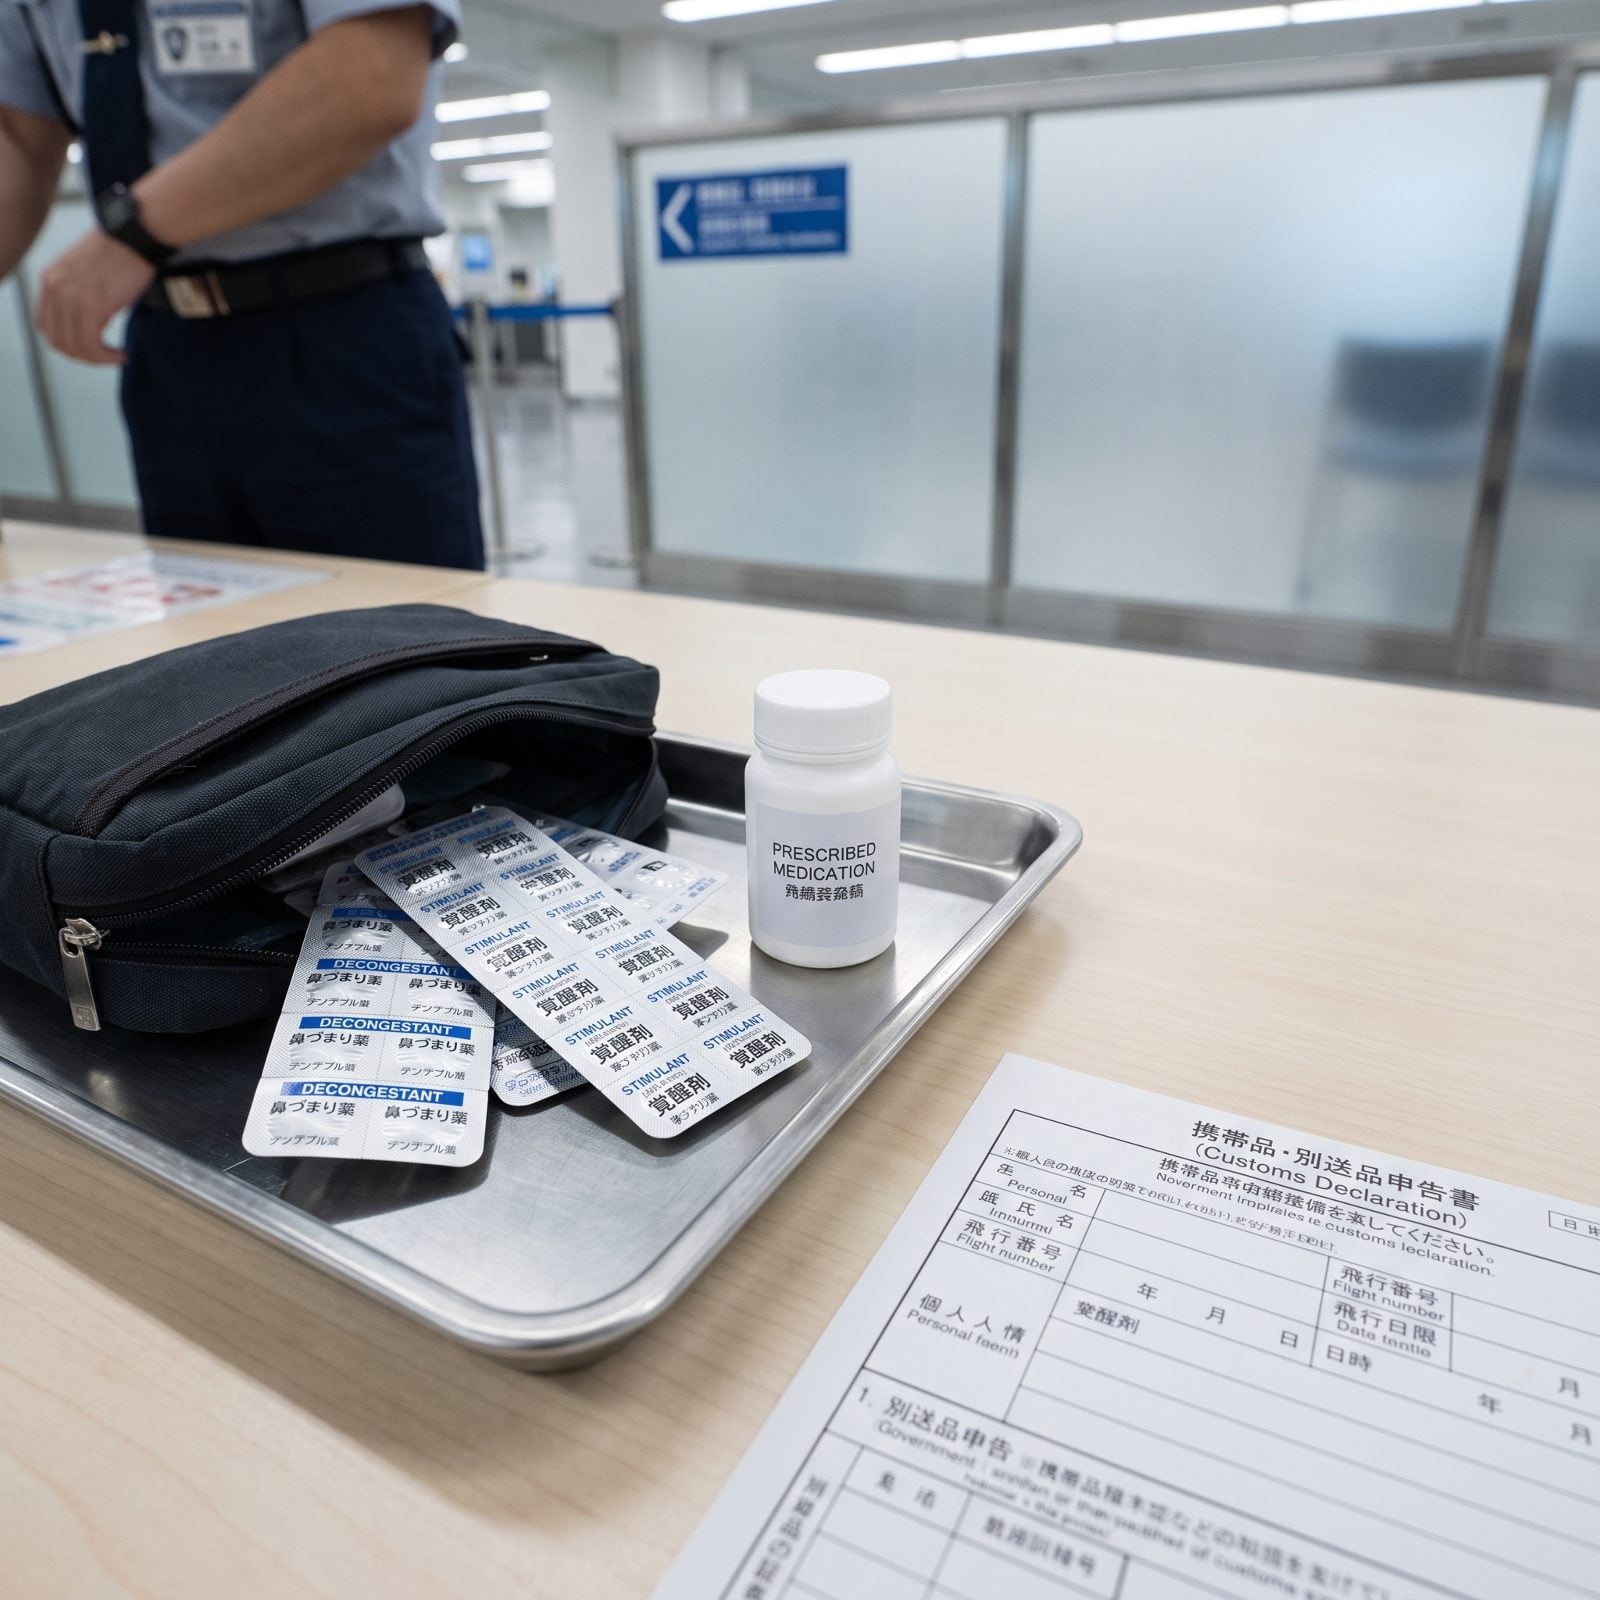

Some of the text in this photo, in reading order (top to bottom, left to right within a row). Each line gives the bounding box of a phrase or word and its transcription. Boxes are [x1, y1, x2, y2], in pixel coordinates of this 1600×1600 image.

[773, 842, 876, 862] PRESCRIBED
[773, 860, 875, 881] MEDICATION
[440, 896, 501, 929] 覚醒剤
[546, 891, 605, 918] STIMULANT
[568, 905, 624, 935] 覚醒剤
[464, 921, 532, 955] STIMULANT
[595, 929, 656, 960] STIMULANT
[618, 944, 676, 977] 覚醒剤
[512, 963, 580, 999] STIMULANT
[536, 978, 599, 1017] 覚醒剤
[647, 970, 708, 1003] STIMULANT
[672, 986, 730, 1021] 覚醒剤
[288, 1032, 370, 1047] 鼻づまり薬
[320, 1017, 452, 1036] DECONGESTANT
[564, 1006, 634, 1046] STIMULANT
[703, 1013, 764, 1050] STIMULANT
[398, 1037, 475, 1056] 鼻づまり薬
[590, 1023, 654, 1065] 覚醒剤
[729, 1030, 787, 1069] 覚醒剤
[621, 1053, 691, 1096] STIMULANT
[270, 1099, 355, 1117] 鼻づまり薬
[301, 1082, 443, 1103] DECONGESTANT
[648, 1072, 712, 1117] 覚醒剤
[384, 1105, 468, 1125] 鼻づまり薬
[1192, 1120, 1480, 1211] 携帯品・別送品申告書
[1007, 1178, 1067, 1205] Personal
[1195, 1143, 1306, 1185] (Customs
[1315, 1174, 1467, 1230] Declaration)
[964, 1219, 1062, 1261] 飛行番号
[1325, 1221, 1396, 1249] customs
[955, 1233, 1055, 1274] Flight number
[1333, 1279, 1446, 1323] Flight number
[1341, 1265, 1439, 1306] 飛行番号
[906, 1309, 973, 1342] Personal
[1136, 1282, 1298, 1349] 年 月 日
[1337, 1318, 1377, 1342] Date
[1557, 1377, 1580, 1399] 月
